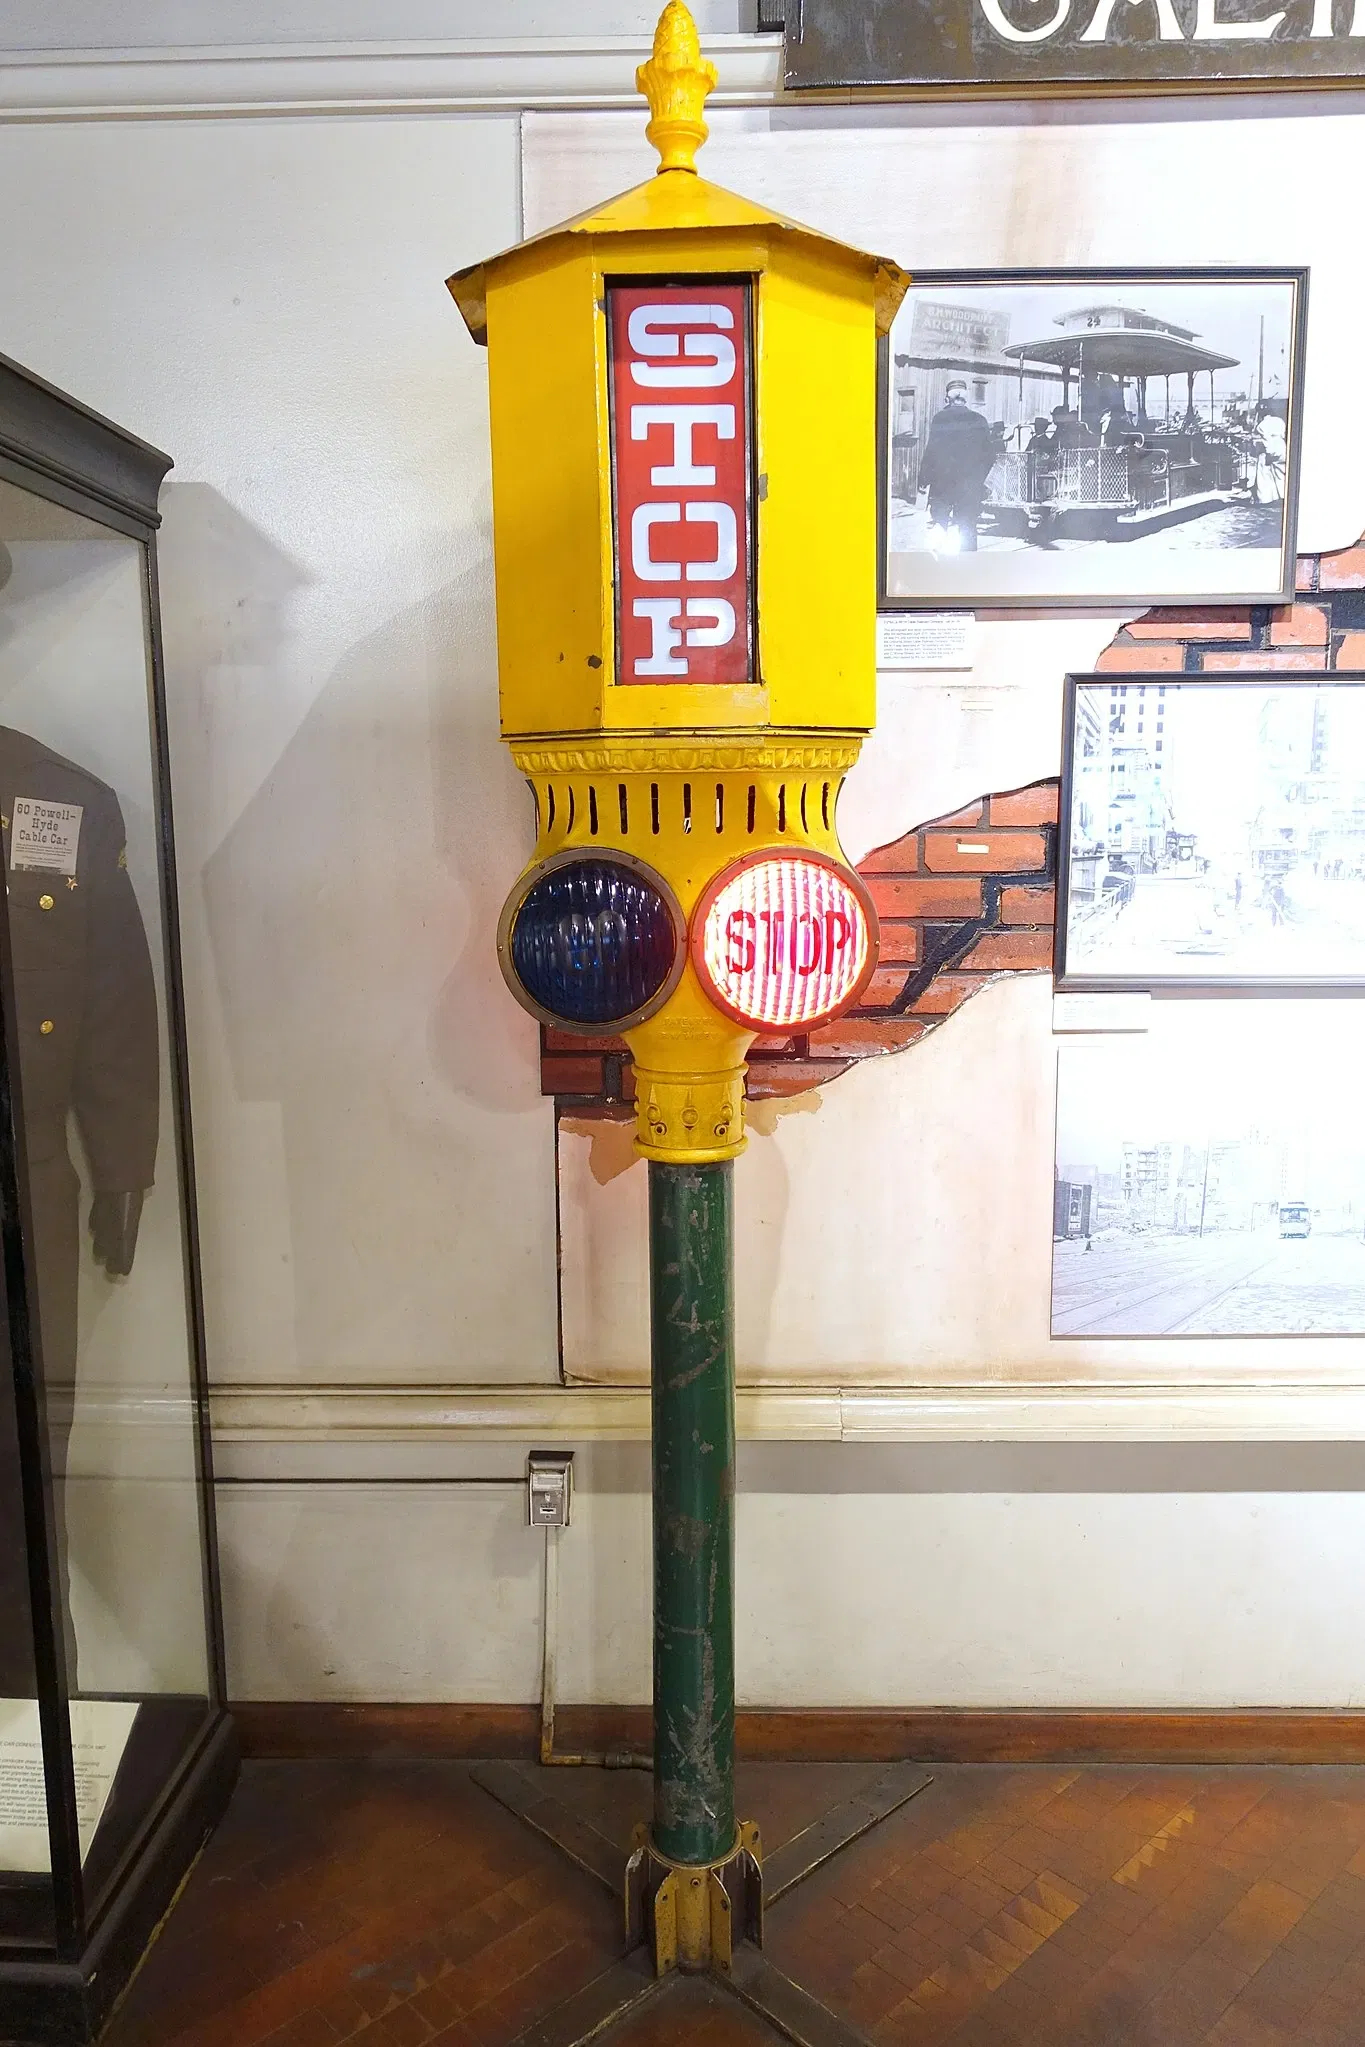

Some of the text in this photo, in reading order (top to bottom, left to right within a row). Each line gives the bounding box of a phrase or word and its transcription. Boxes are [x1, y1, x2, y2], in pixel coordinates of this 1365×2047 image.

[920, 317, 1000, 337] ARCHITECT
[627, 303, 738, 676] STOP
[17, 803, 30, 815] 60
[31, 818, 59, 832] Hyde
[19, 830, 68, 845] Cable Car
[726, 909, 851, 976] STOP
